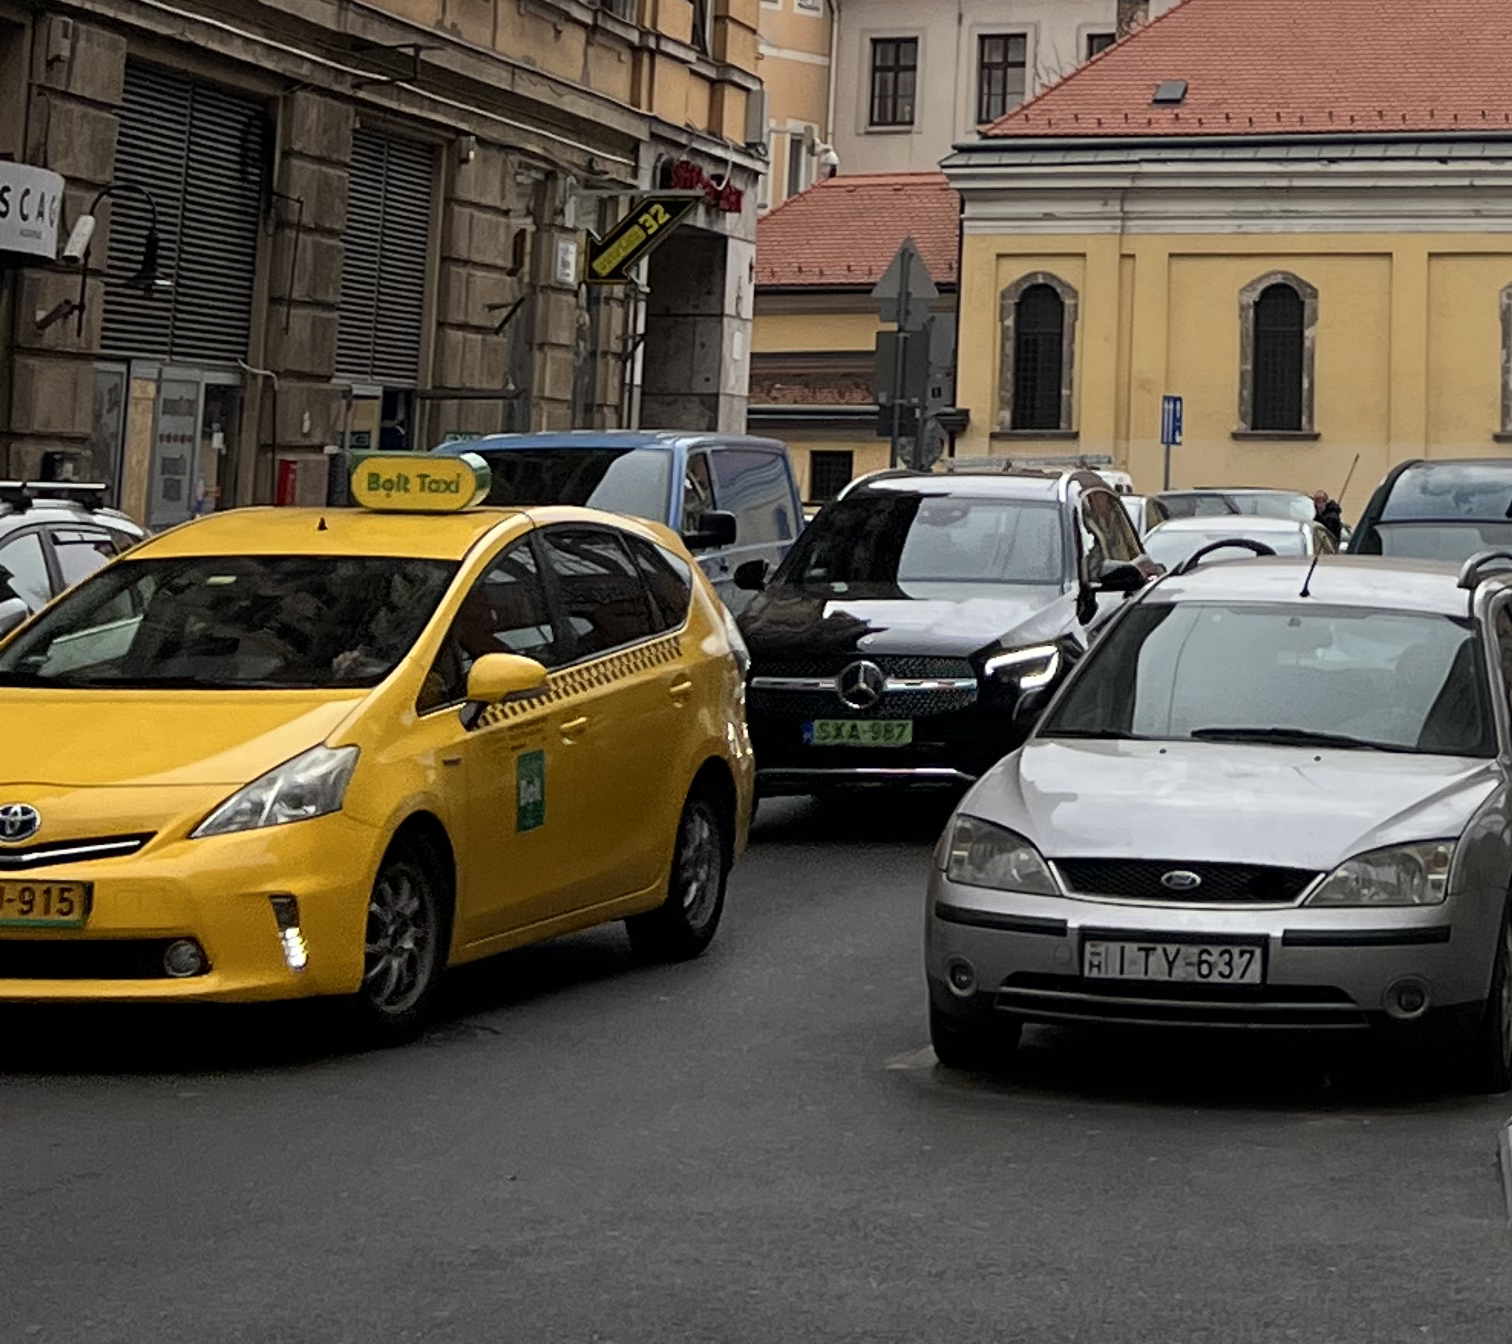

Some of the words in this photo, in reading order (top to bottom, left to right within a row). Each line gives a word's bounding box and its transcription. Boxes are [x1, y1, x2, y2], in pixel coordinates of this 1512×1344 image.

[638, 203, 671, 235] 32
[367, 472, 410, 497] Bolt
[417, 473, 461, 494] Taxi
[1119, 945, 1255, 980] ITY-637
